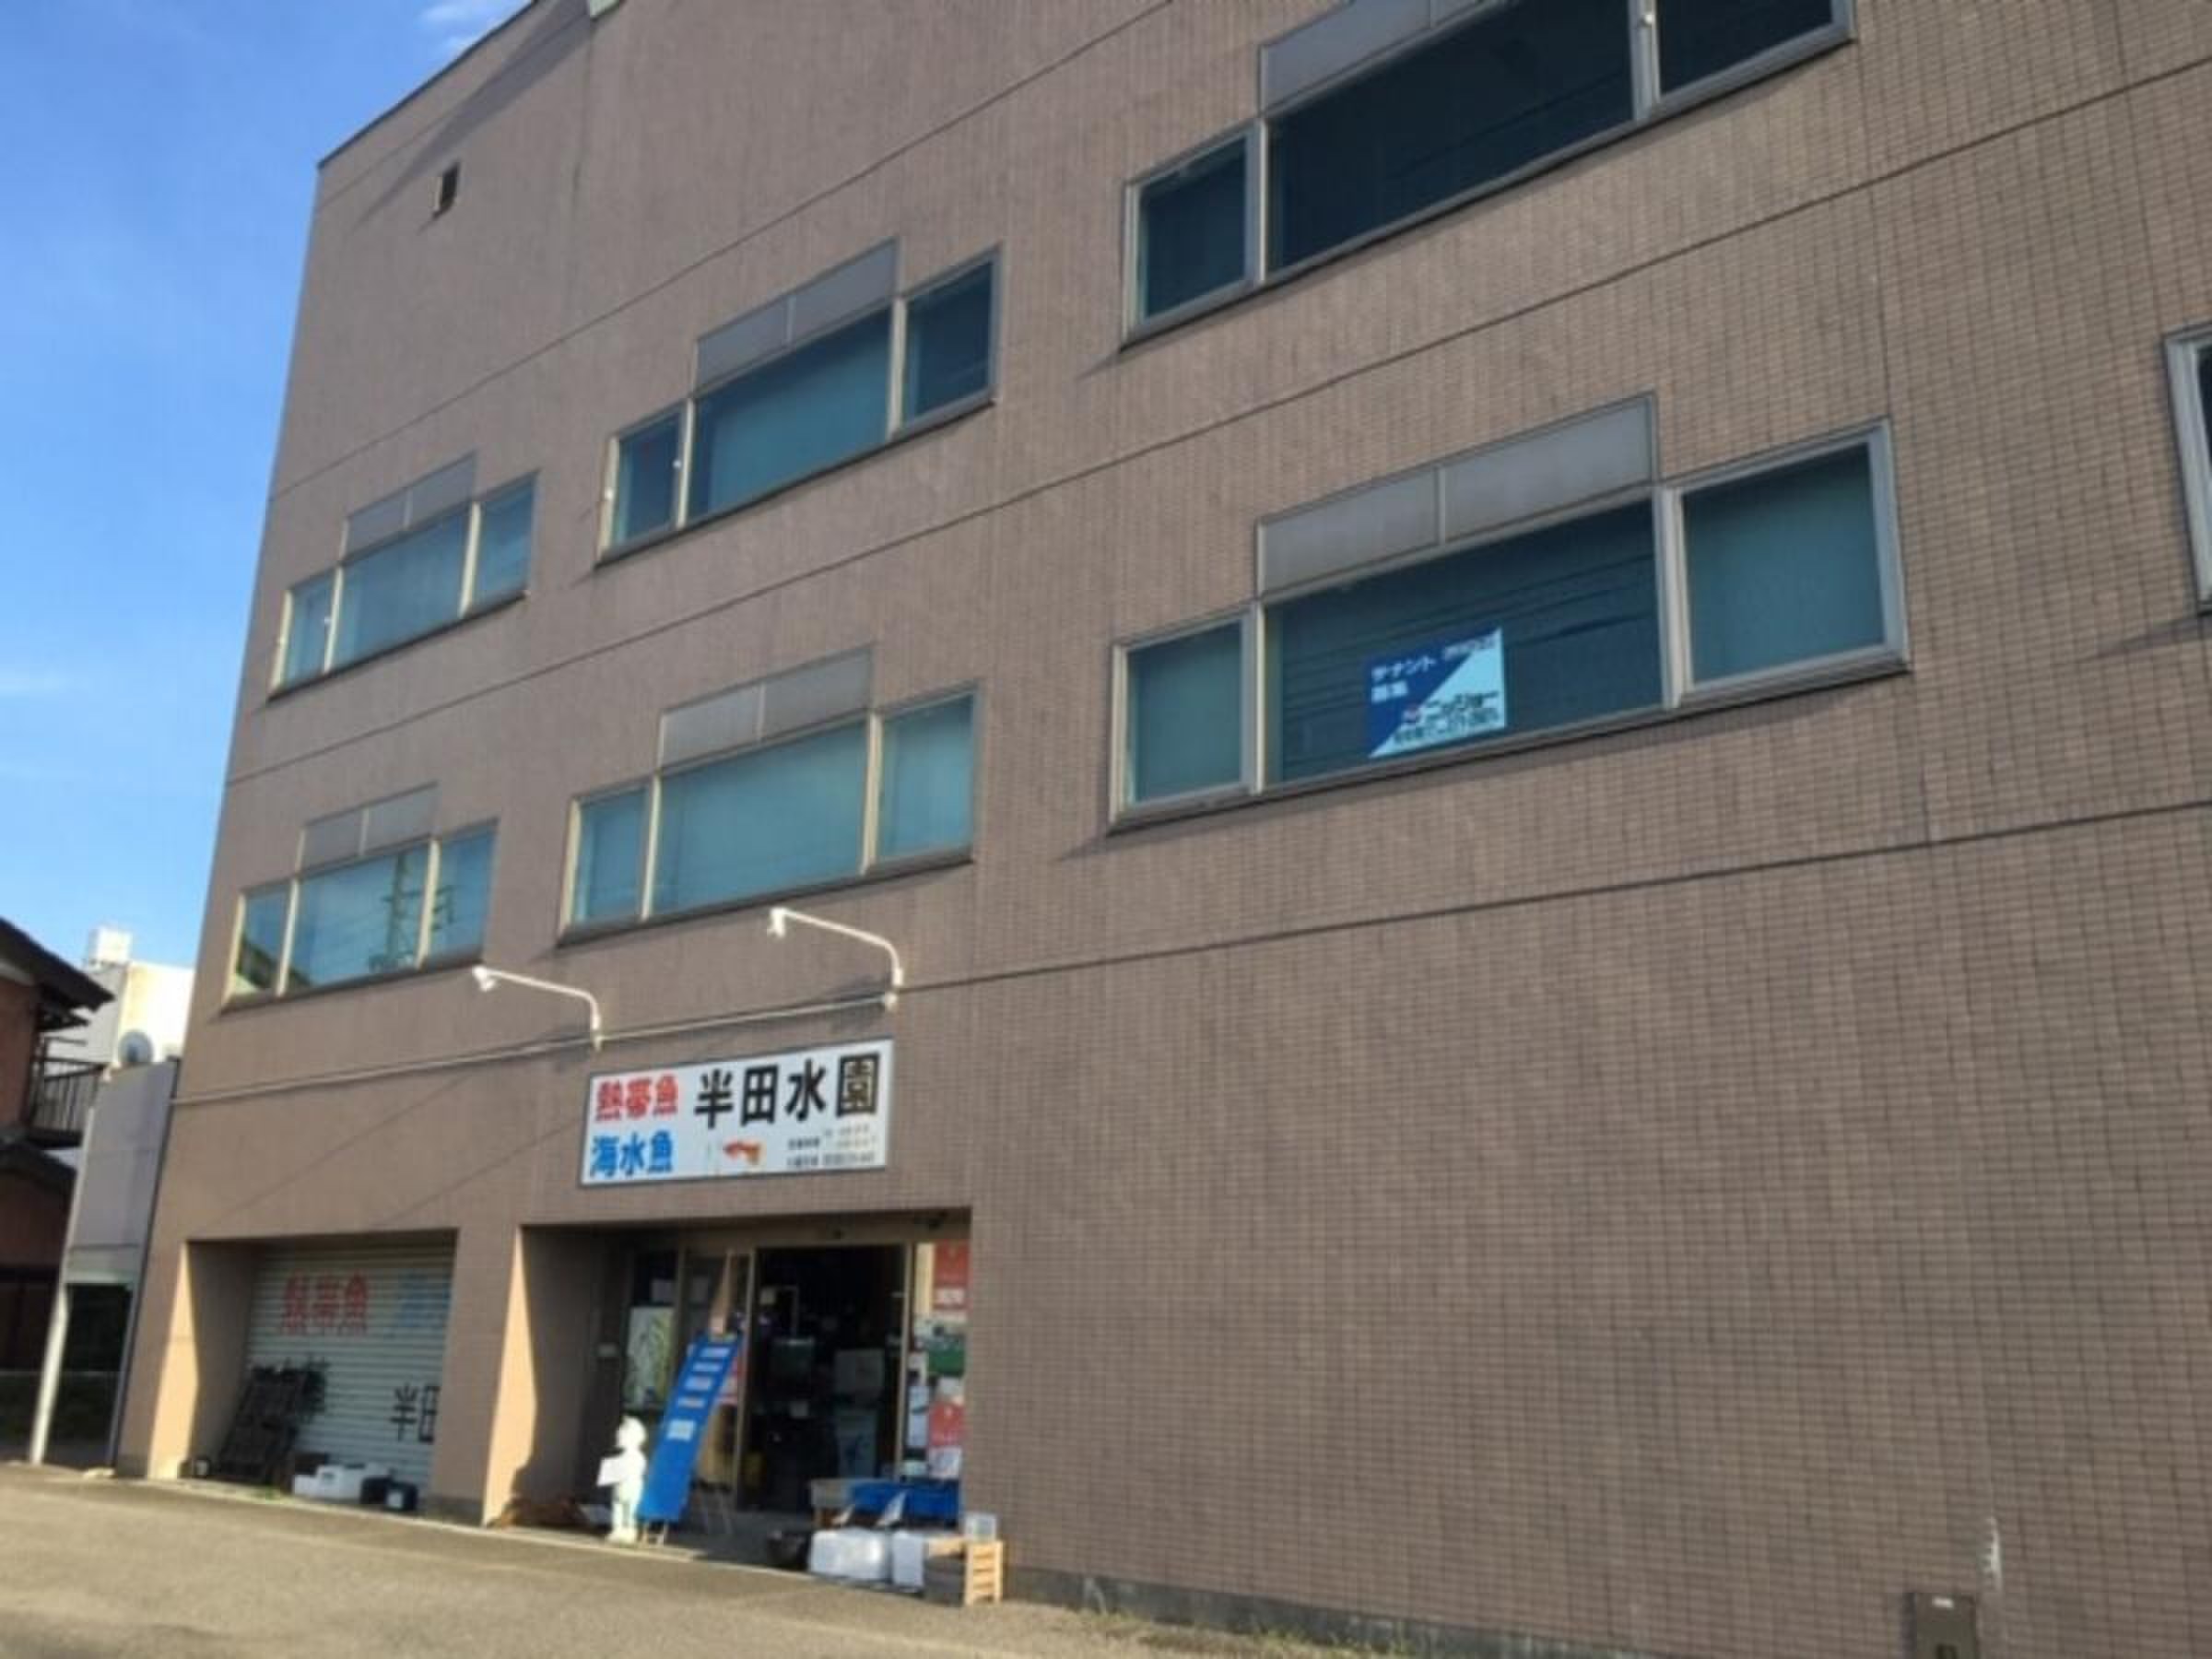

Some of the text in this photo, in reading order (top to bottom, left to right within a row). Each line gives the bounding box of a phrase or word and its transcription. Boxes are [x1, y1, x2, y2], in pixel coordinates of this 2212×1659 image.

[694, 1053, 881, 1130] 半田水園
[590, 1129, 675, 1178] 海水魚
